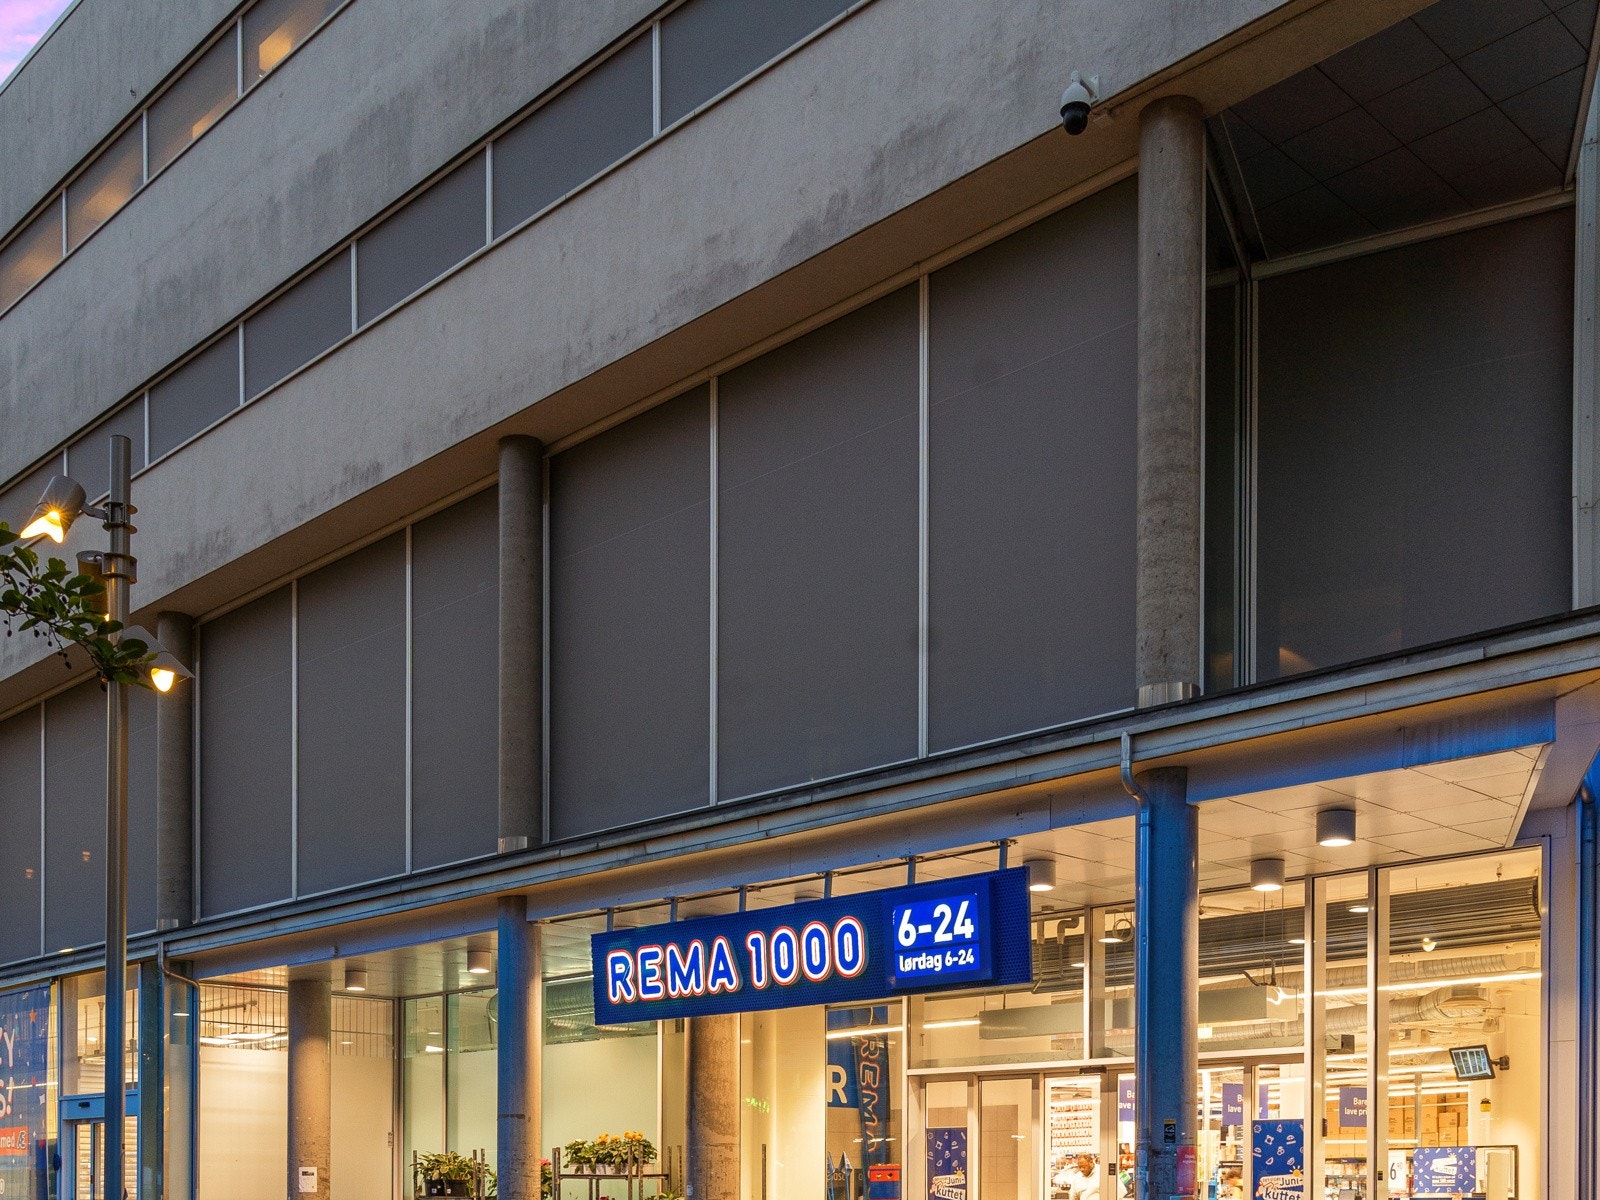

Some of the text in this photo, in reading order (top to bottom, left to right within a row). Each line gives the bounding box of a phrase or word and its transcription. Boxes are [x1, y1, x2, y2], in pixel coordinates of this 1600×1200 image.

[898, 900, 974, 947] 6-24
[607, 916, 864, 1004] REMA 1000
[899, 948, 974, 972] lørdag 6-24
[1227, 1104, 1242, 1113] lave
[1344, 1107, 1357, 1115] lave
[1390, 1162, 1396, 1180] 6
[1280, 1177, 1302, 1186] Juni-
[936, 1184, 963, 1200] kuttet
